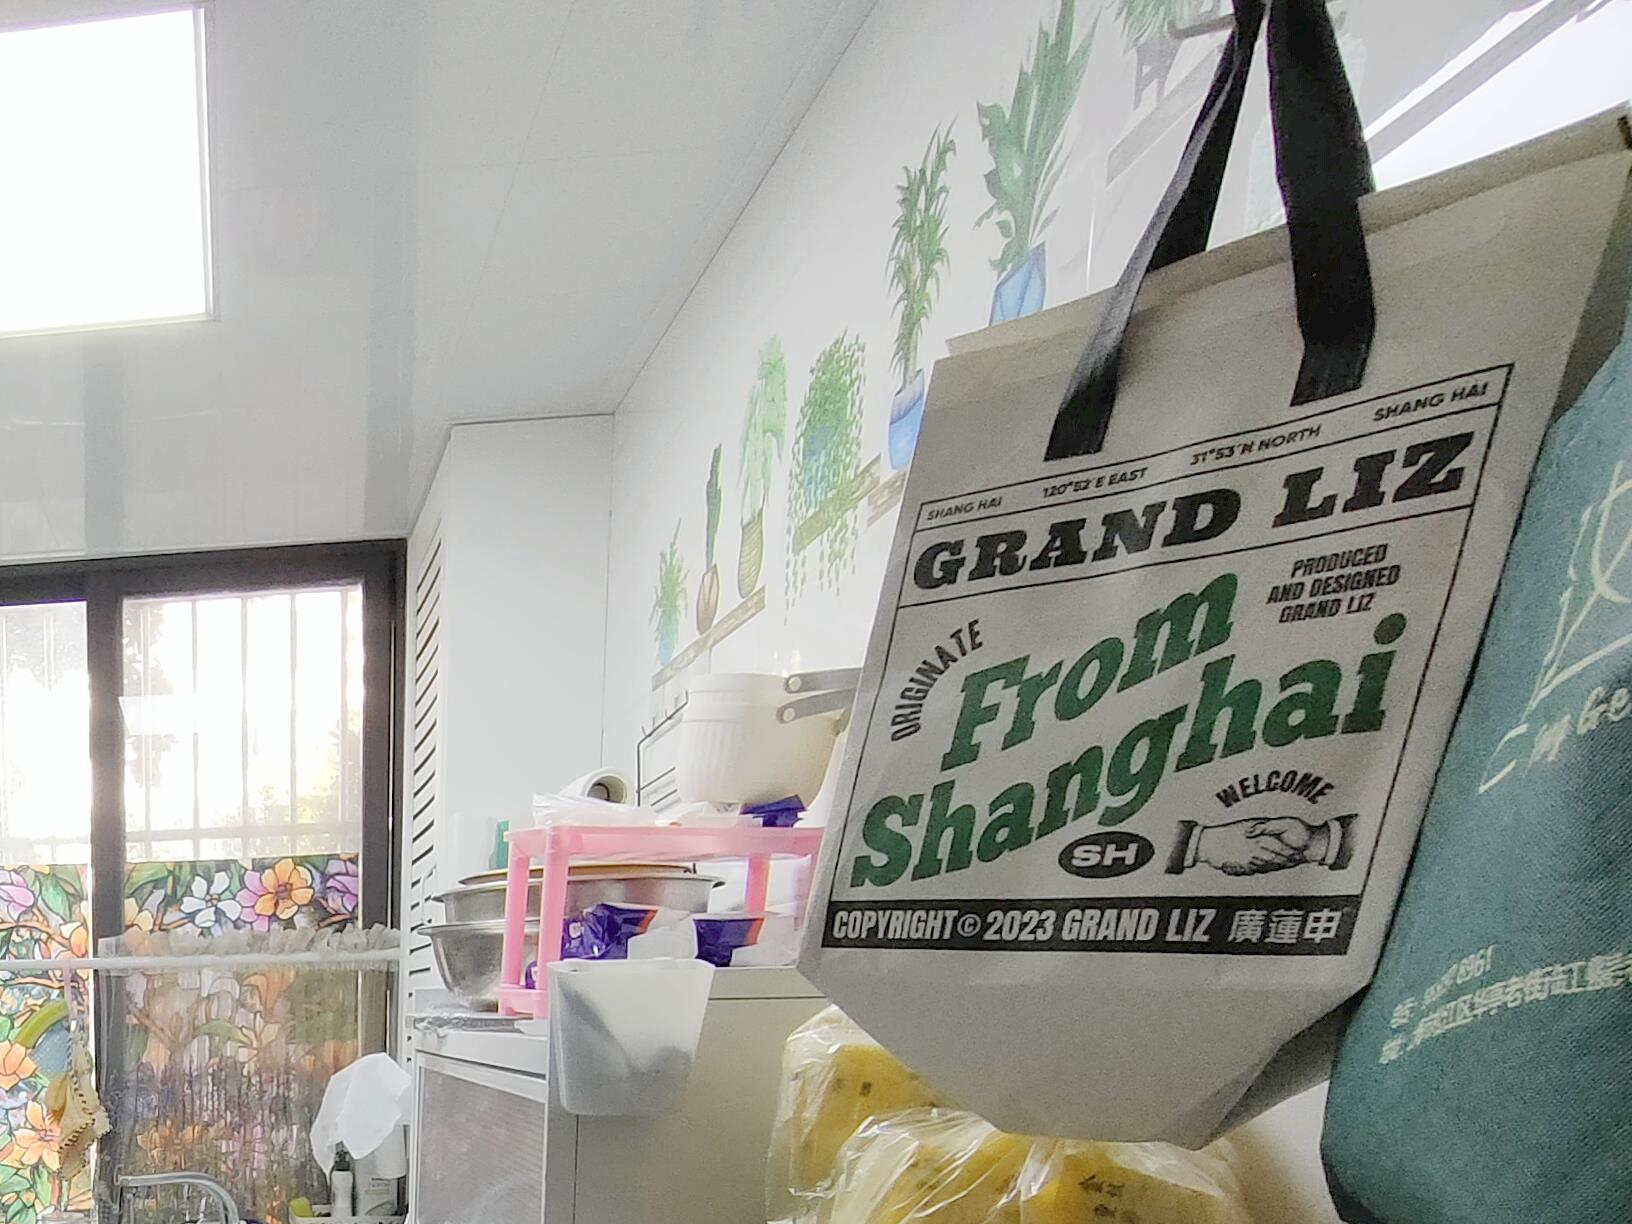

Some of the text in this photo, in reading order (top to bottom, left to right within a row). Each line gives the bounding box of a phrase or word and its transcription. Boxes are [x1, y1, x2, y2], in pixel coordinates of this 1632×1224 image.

[1373, 382, 1489, 422] SHANG HAI
[1257, 424, 1322, 450] NORTH
[1108, 467, 1148, 486] EAST
[913, 431, 1475, 589] GRAND LIZ
[927, 496, 1003, 520] SHANG HAI
[1290, 543, 1389, 578] PRODUCED
[1266, 564, 1401, 604] AND DESIGNED
[1279, 593, 1376, 623] GRAND LIZ
[891, 618, 984, 742] ORIGINATE
[940, 572, 1239, 772] From
[850, 612, 1408, 888] Shanghai
[1215, 769, 1335, 808] WELCOME
[1071, 843, 1139, 867] SH
[983, 909, 1054, 941] 2023
[1062, 908, 1163, 941] GRAND
[1167, 908, 1213, 941] LIZ
